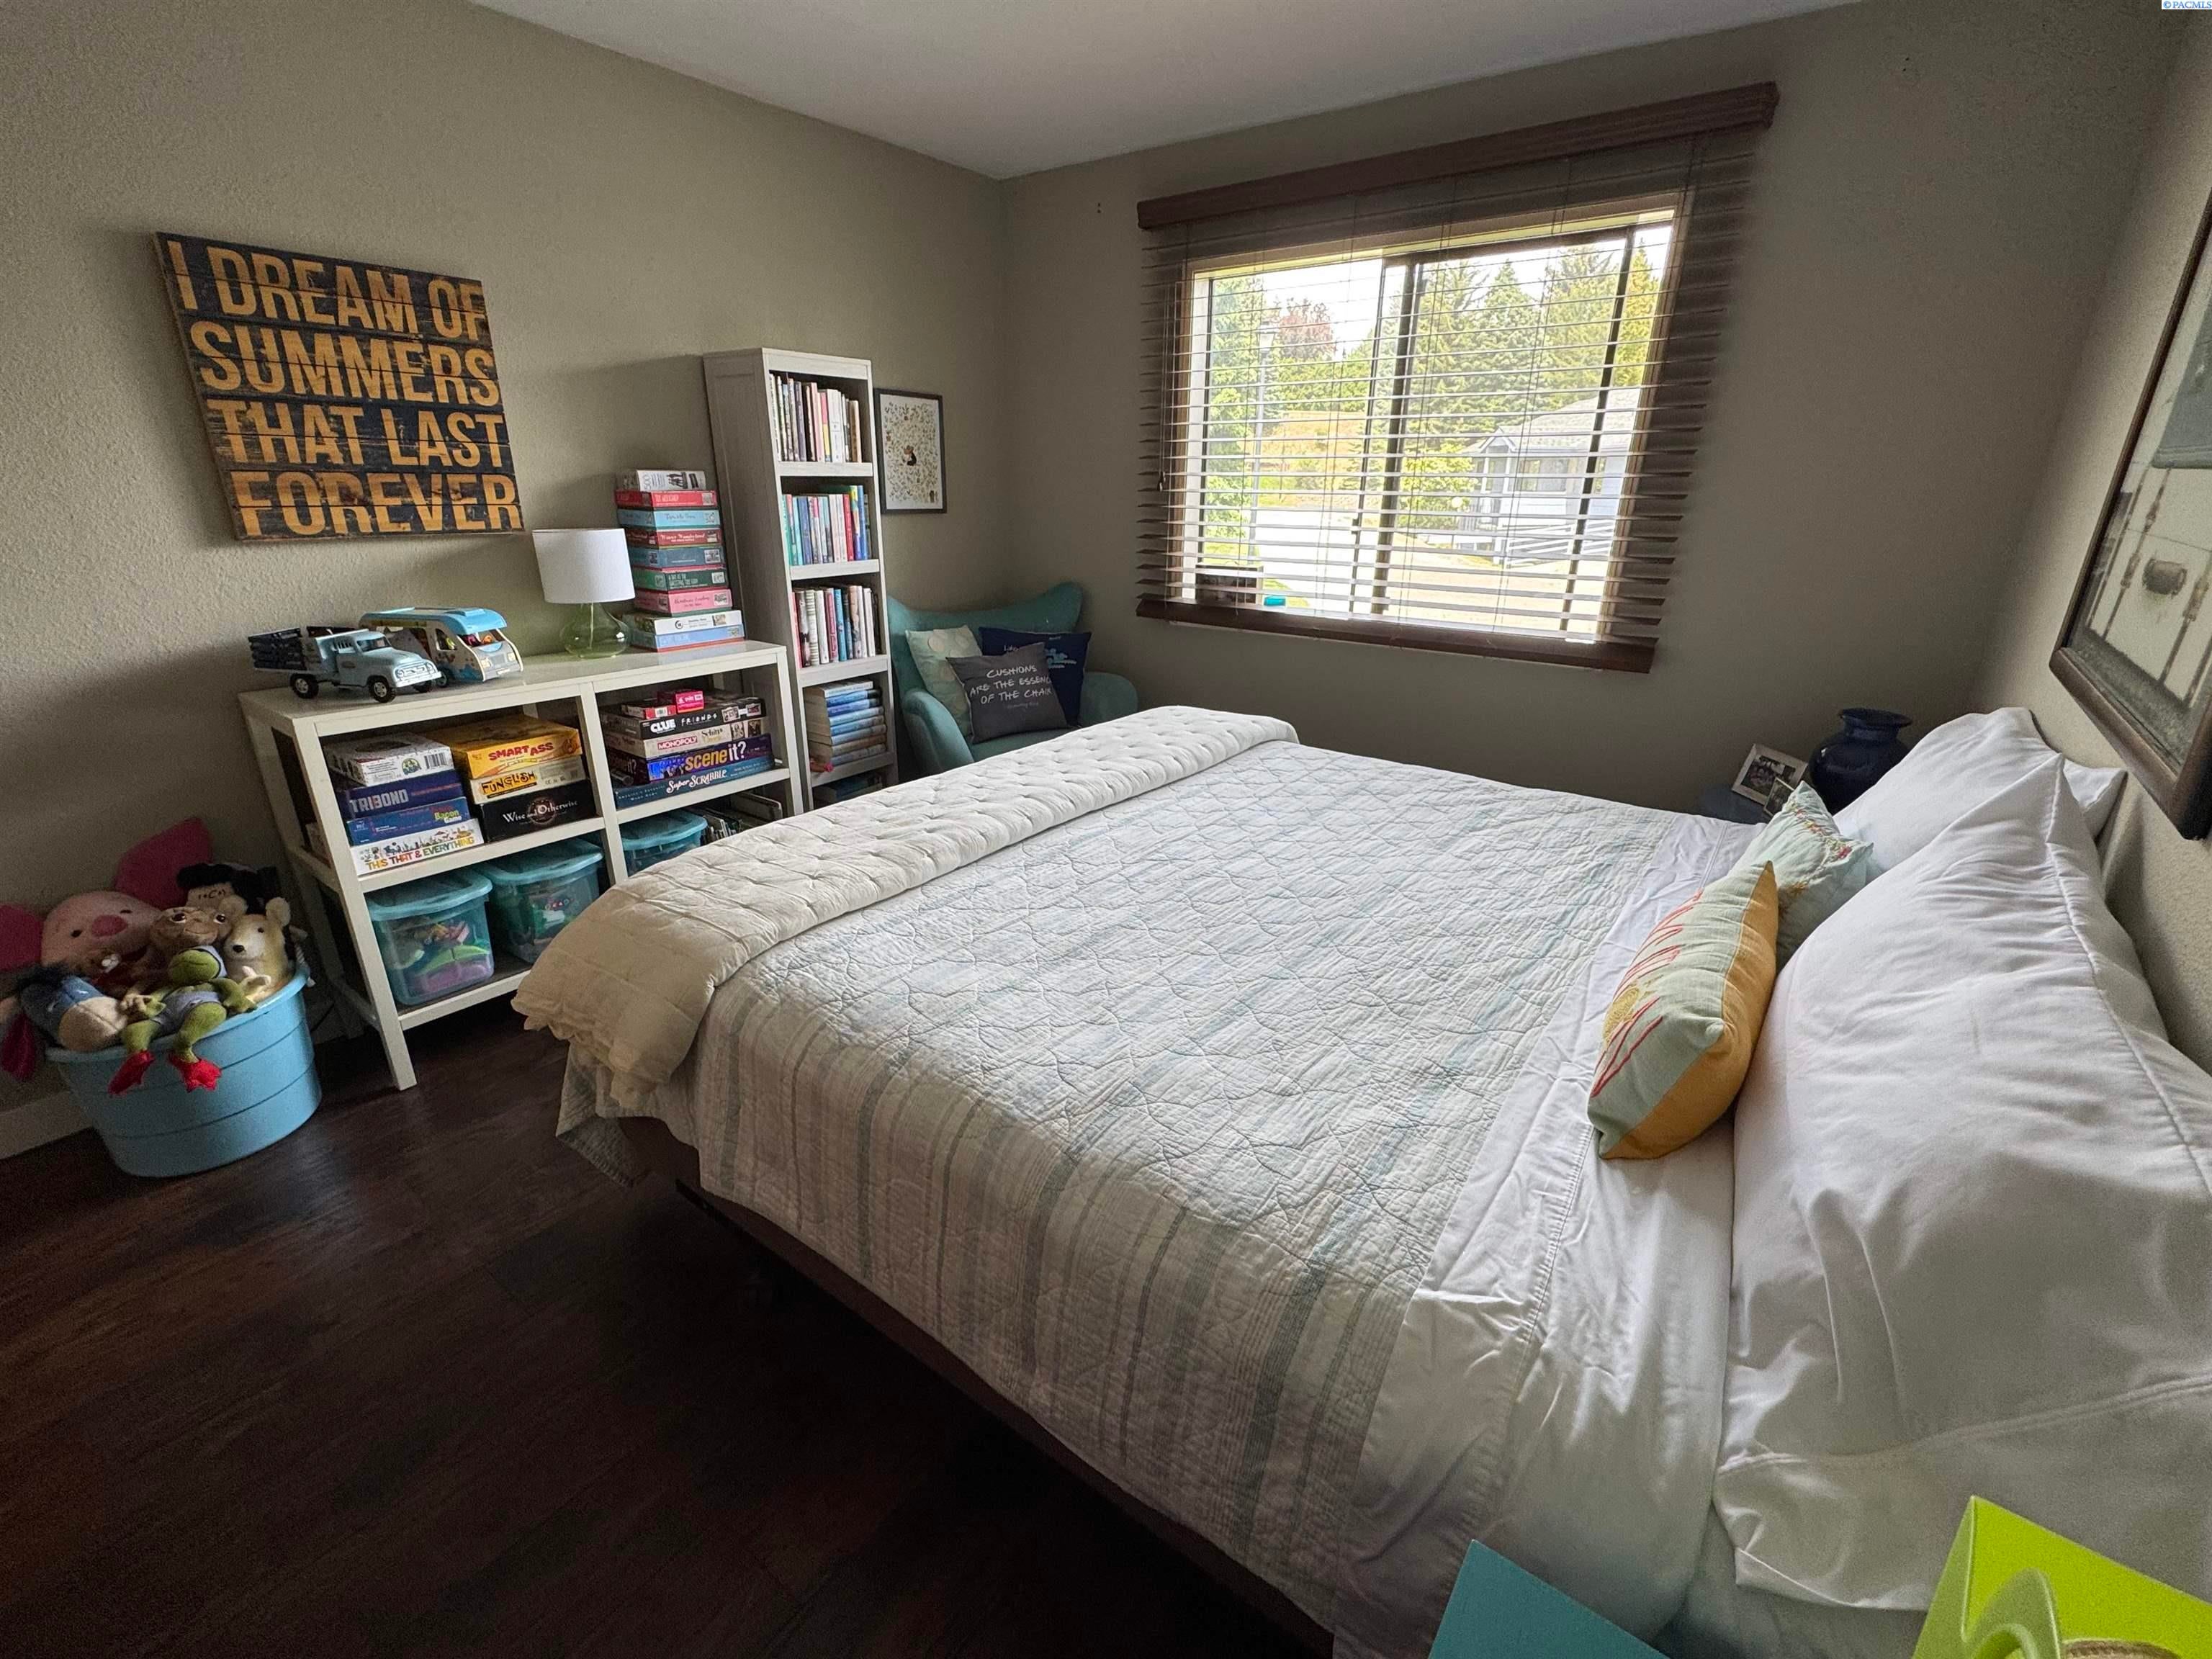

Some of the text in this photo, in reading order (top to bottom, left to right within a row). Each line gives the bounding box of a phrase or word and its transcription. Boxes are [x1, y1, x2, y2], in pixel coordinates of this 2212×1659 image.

[167, 240, 487, 341] I DREAM OF
[190, 321, 500, 407] SUMMERS
[207, 398, 504, 468] THAT LAST
[230, 470, 521, 536] FOREVER
[986, 665, 1038, 678] CUSHIONS
[970, 675, 1051, 697] ARE THE ESSENC
[981, 693, 995, 704] OF
[999, 690, 1020, 702] THE
[650, 719, 676, 732] CLUE
[488, 742, 554, 761] SMART ASS
[658, 736, 698, 750] MONOPOLY
[685, 740, 747, 772] scene it?
[666, 780, 691, 793] Super
[689, 770, 727, 788] SCRABBLE
[349, 789, 409, 813] TRIBOND
[434, 809, 459, 821] Bacon
[503, 811, 526, 823] Wise
[367, 836, 475, 870] THIS THAT & EVERYTHING
